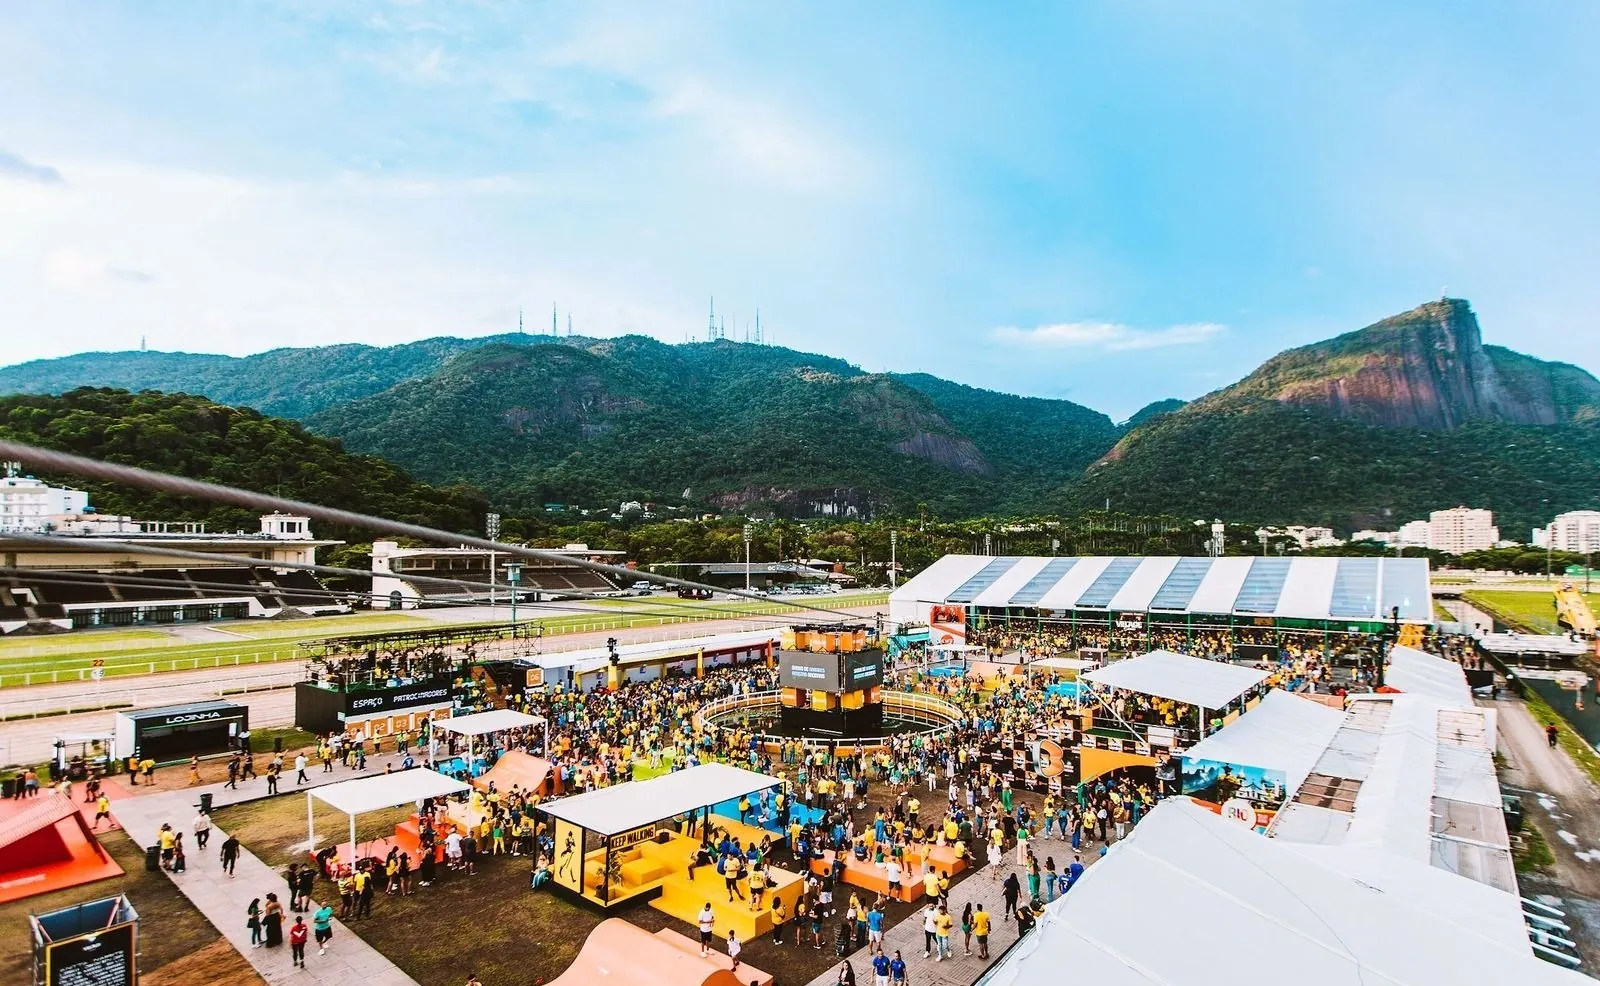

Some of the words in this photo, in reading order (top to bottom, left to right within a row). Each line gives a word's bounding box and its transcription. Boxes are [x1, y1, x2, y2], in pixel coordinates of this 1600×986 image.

[93, 659, 104, 667] 22
[353, 697, 383, 709] ESPAÇO
[396, 719, 407, 729] 03
[1228, 807, 1249, 822] RIO
[611, 834, 626, 849] KEEP
[627, 826, 654, 845] WALKING
